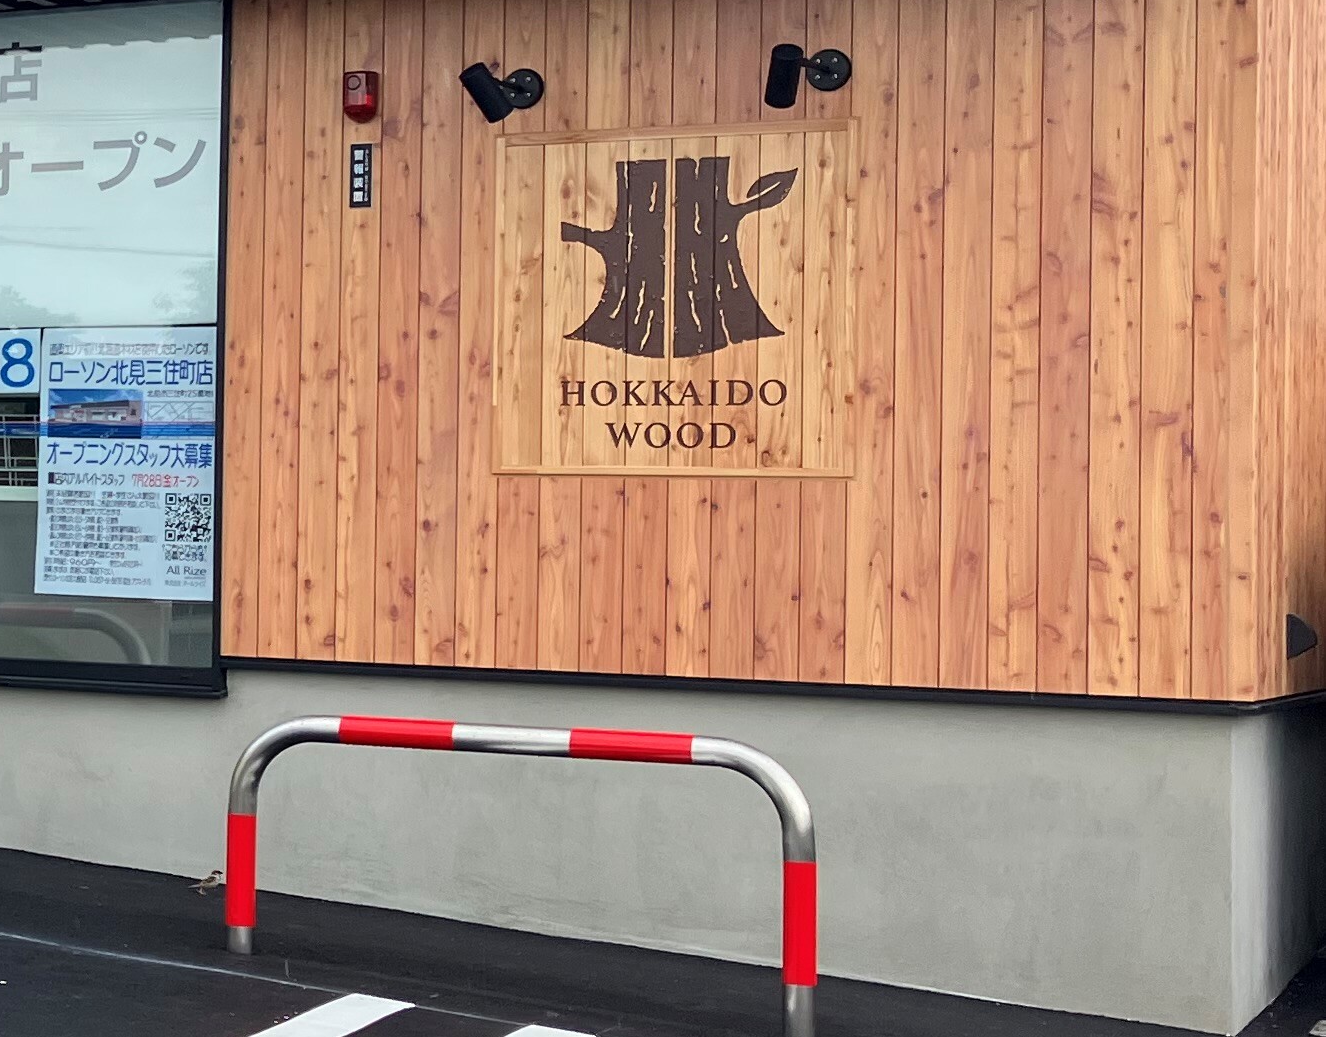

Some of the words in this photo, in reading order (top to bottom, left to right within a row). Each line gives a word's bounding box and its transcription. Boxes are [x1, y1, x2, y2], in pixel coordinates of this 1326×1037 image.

[48, 359, 214, 386] ローソン北見三住町店
[559, 378, 788, 408] HOKKAIDO
[604, 421, 737, 449] WOOD
[47, 442, 213, 468] オープニングスタッフ大募集
